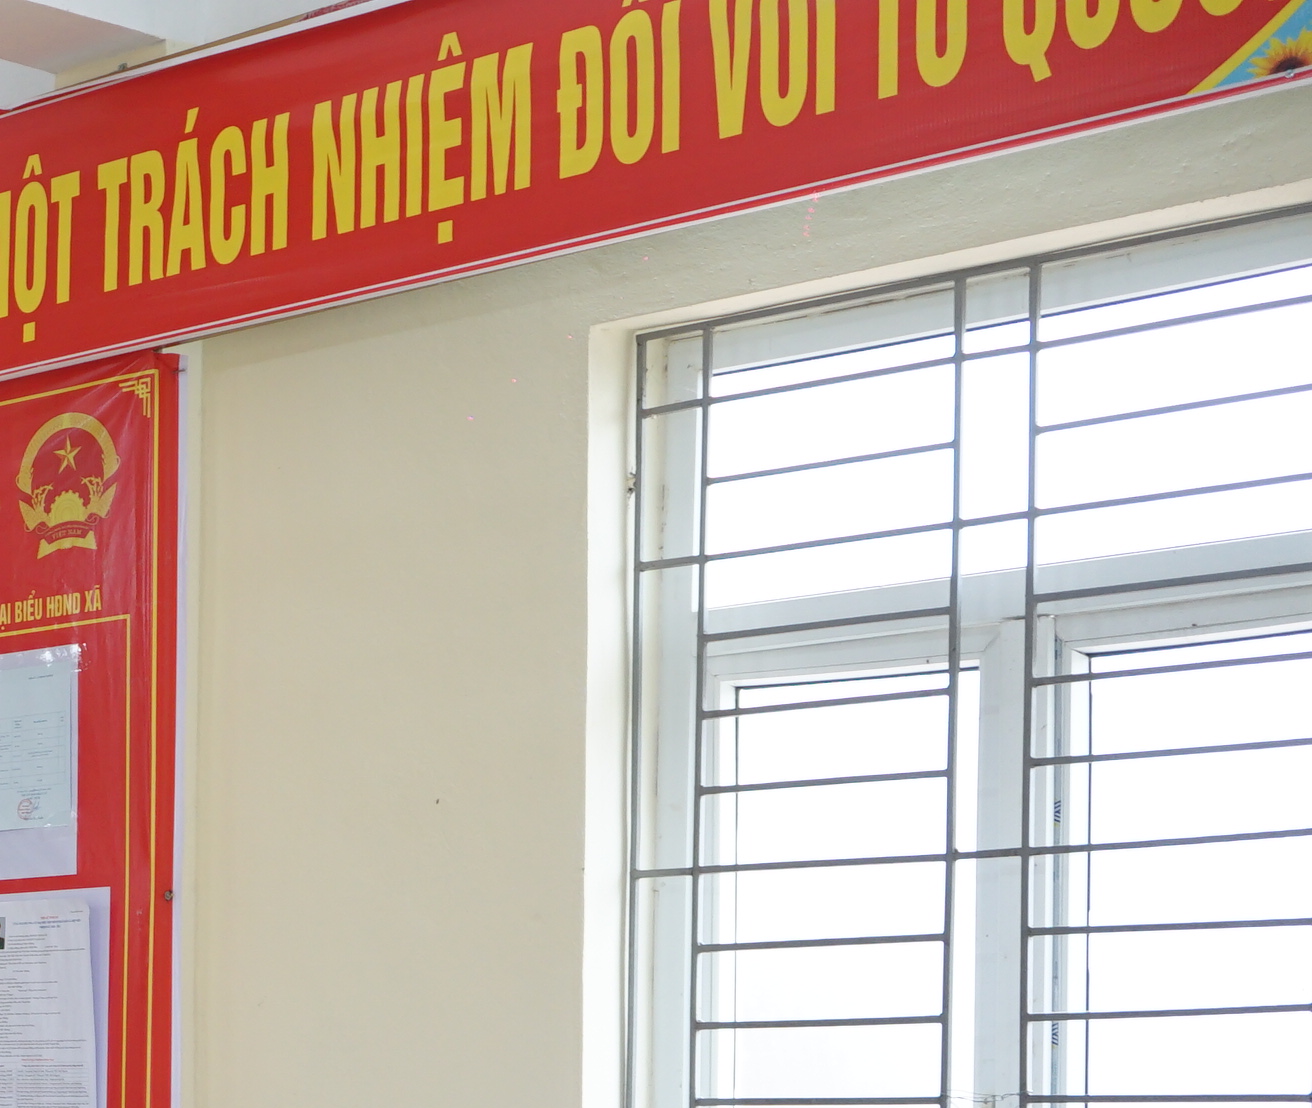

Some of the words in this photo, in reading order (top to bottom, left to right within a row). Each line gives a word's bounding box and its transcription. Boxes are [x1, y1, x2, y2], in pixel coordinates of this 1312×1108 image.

[97, 108, 290, 294] TRÁCH
[312, 31, 534, 244] NHIỆM
[15, 590, 42, 622] BIỂU
[46, 594, 80, 618] HĐND
[84, 584, 101, 612] XÃ
